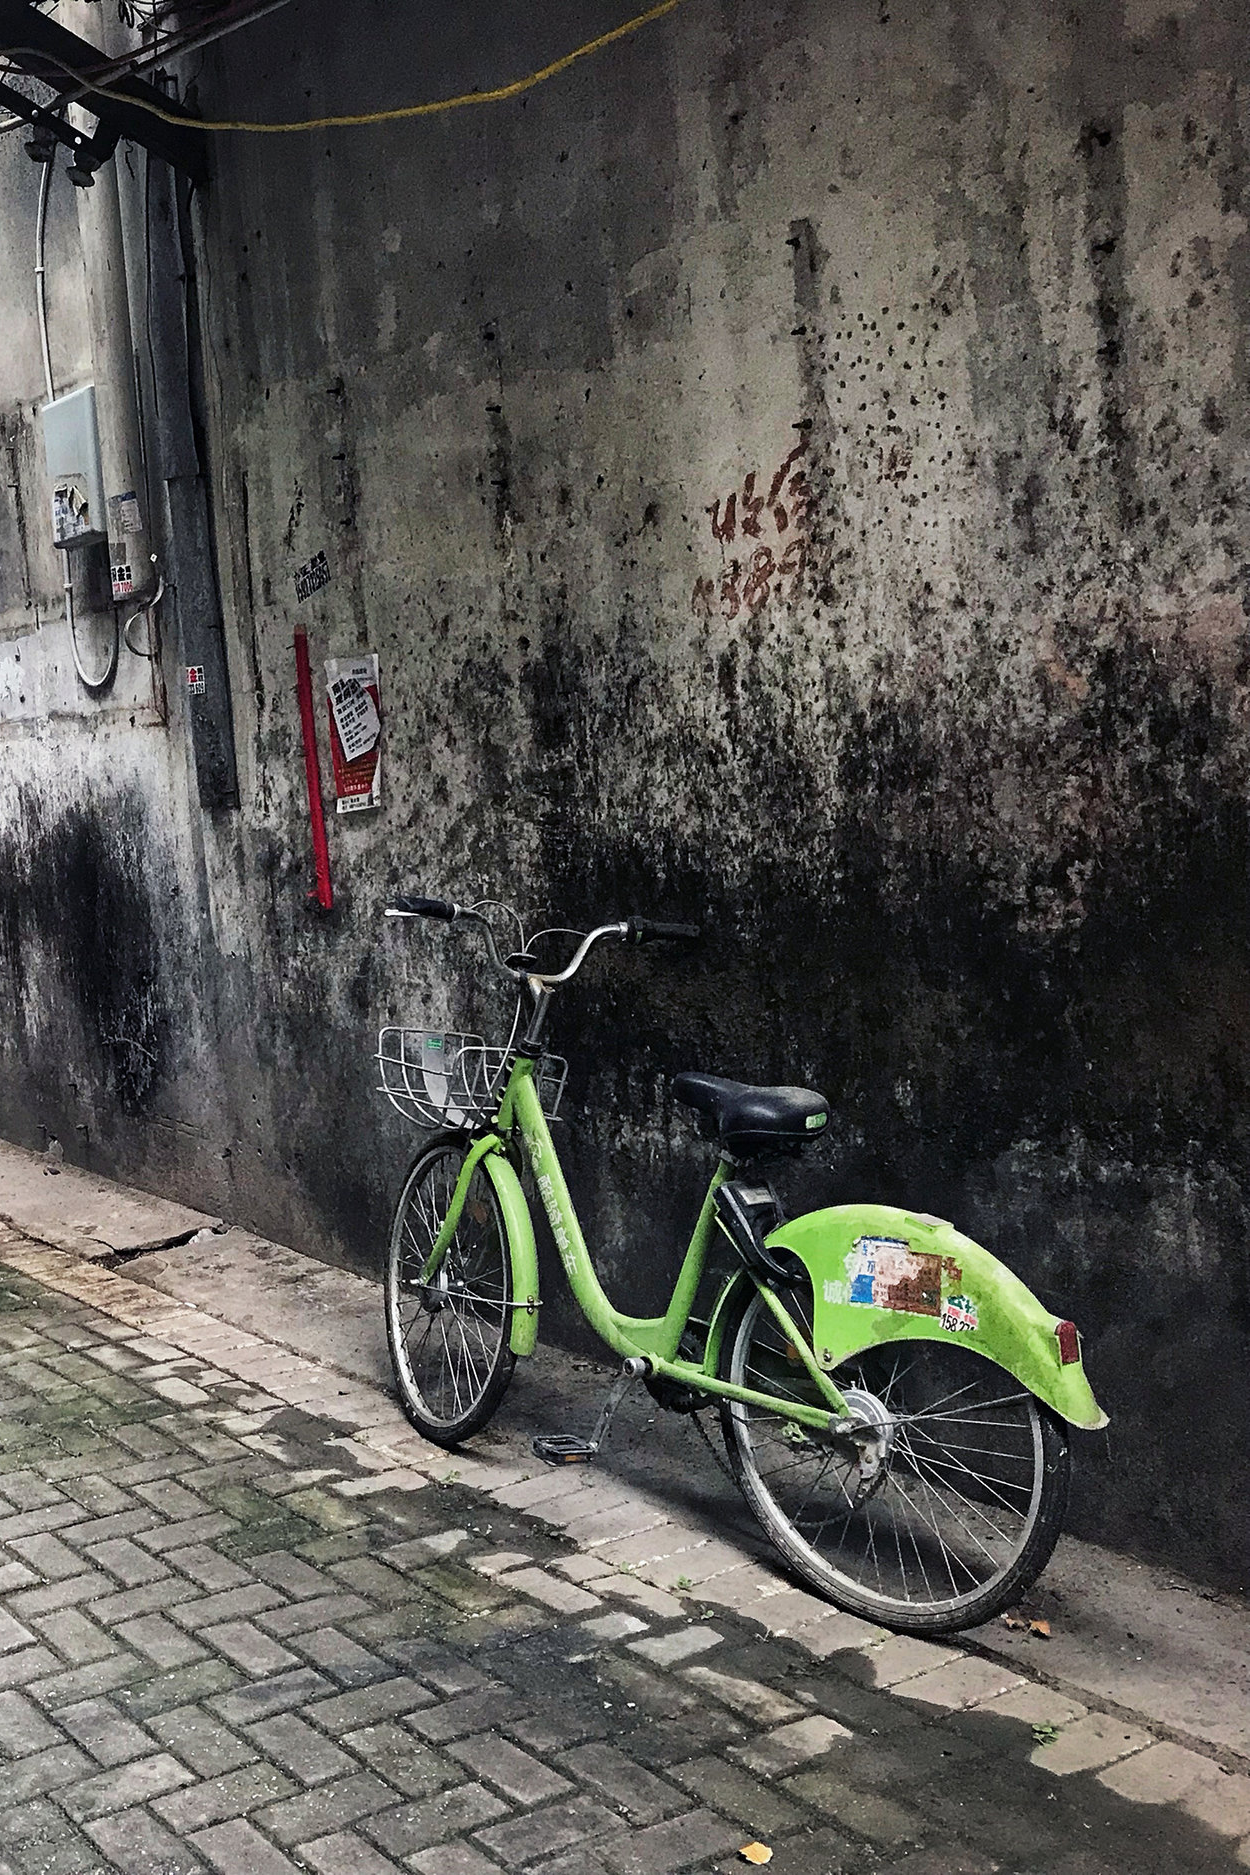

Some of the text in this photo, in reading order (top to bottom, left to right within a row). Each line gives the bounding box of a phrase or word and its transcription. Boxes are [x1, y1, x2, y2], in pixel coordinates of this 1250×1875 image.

[536, 1173, 579, 1277] 酷骑单车
[941, 1312, 959, 1332] 158
